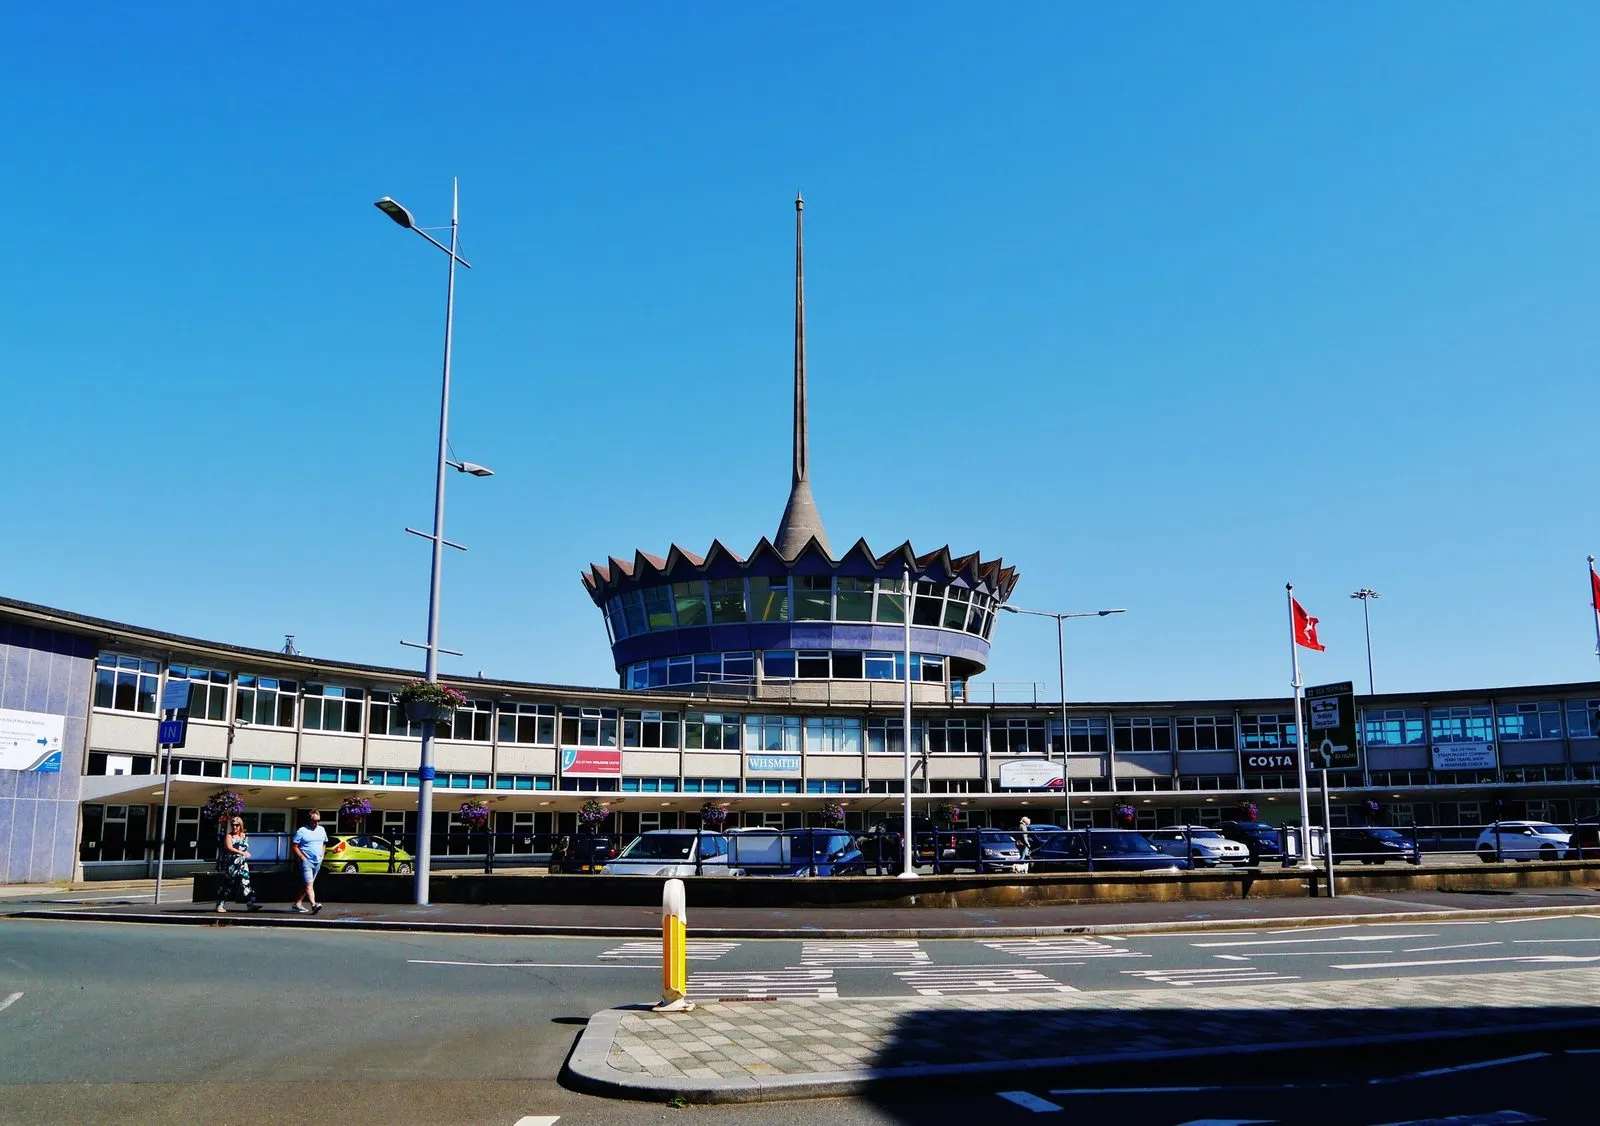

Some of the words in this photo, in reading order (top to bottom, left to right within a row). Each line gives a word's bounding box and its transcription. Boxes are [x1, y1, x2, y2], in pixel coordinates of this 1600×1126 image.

[163, 726, 177, 738] IN
[749, 758, 799, 768] WHSMITH
[1248, 755, 1293, 767] COSTA
[1118, 967, 1302, 986] ALL
